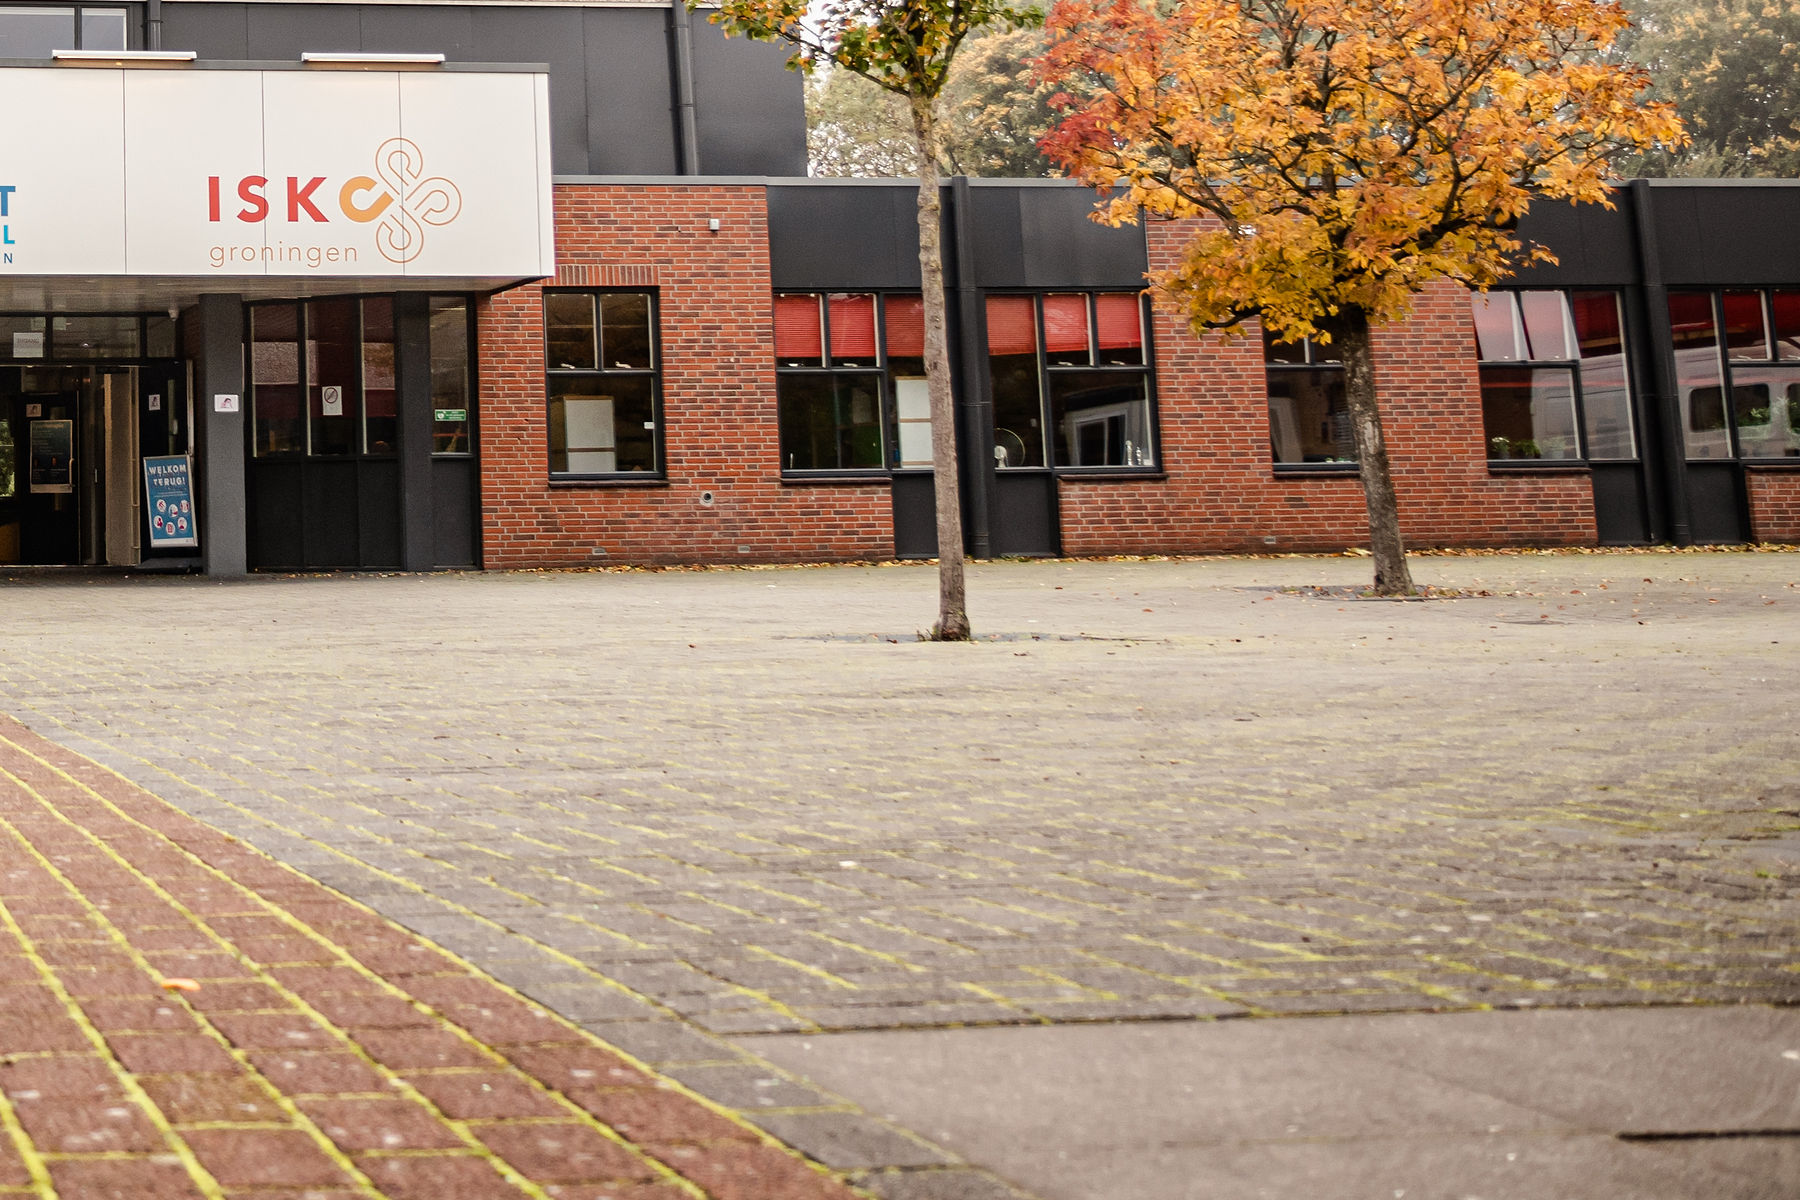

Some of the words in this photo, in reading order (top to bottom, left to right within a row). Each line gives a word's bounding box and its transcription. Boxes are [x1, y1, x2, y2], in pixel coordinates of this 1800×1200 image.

[209, 240, 358, 268] groningen
[148, 464, 187, 475] WELKOM
[153, 477, 186, 487] TERUG!
